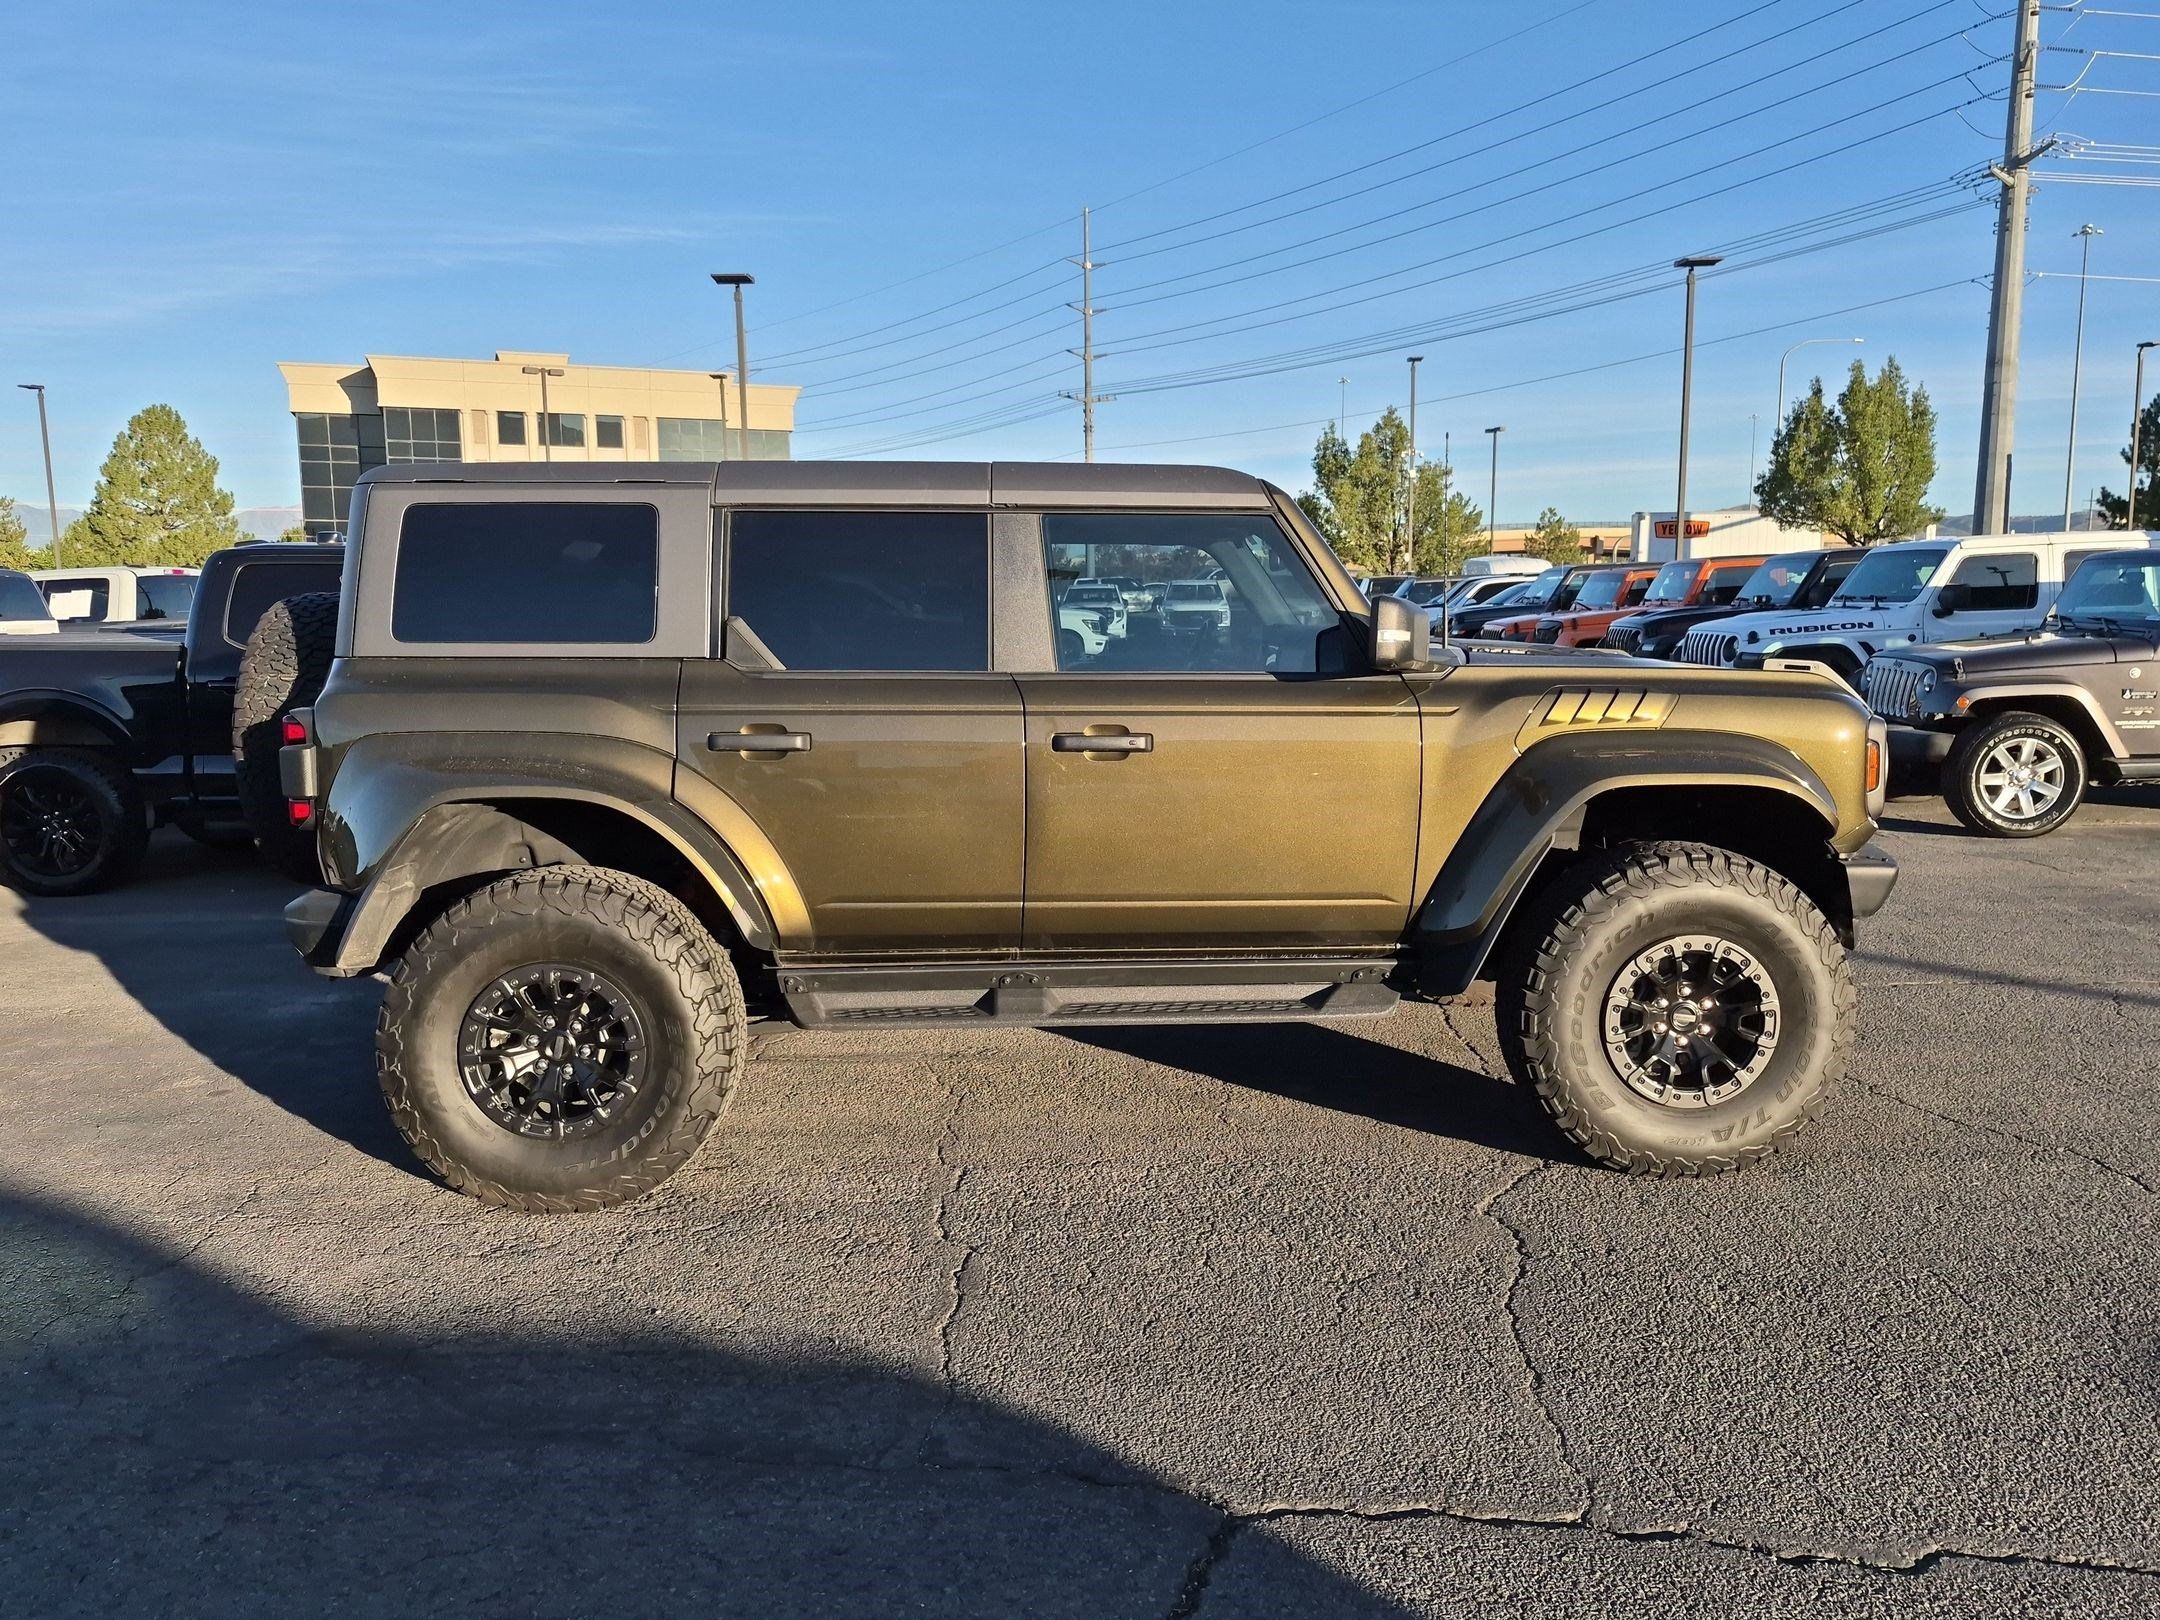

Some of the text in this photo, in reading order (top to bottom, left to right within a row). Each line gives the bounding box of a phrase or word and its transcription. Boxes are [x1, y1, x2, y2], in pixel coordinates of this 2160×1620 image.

[1662, 524, 1703, 535] YELOW
[1769, 621, 1874, 636] RUBICON
[1570, 911, 1655, 1111] BFGoodrich
